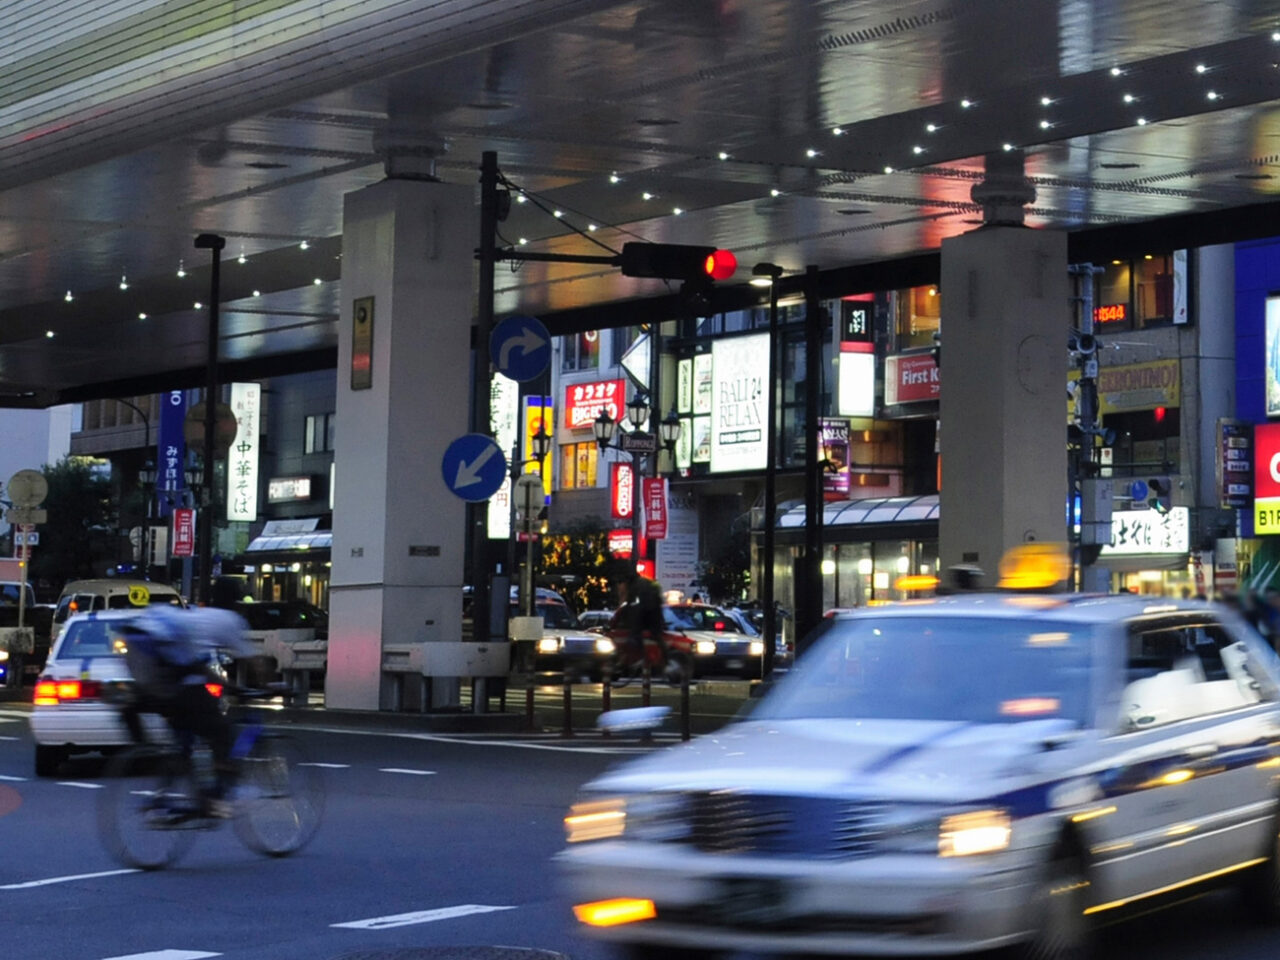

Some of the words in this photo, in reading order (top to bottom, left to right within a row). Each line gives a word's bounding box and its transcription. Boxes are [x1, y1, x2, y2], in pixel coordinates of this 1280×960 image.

[902, 368, 928, 386] First
[574, 383, 617, 401] カラオケ
[572, 406, 590, 425] BIG
[591, 402, 618, 420] ECO
[234, 440, 252, 514] 中華そば
